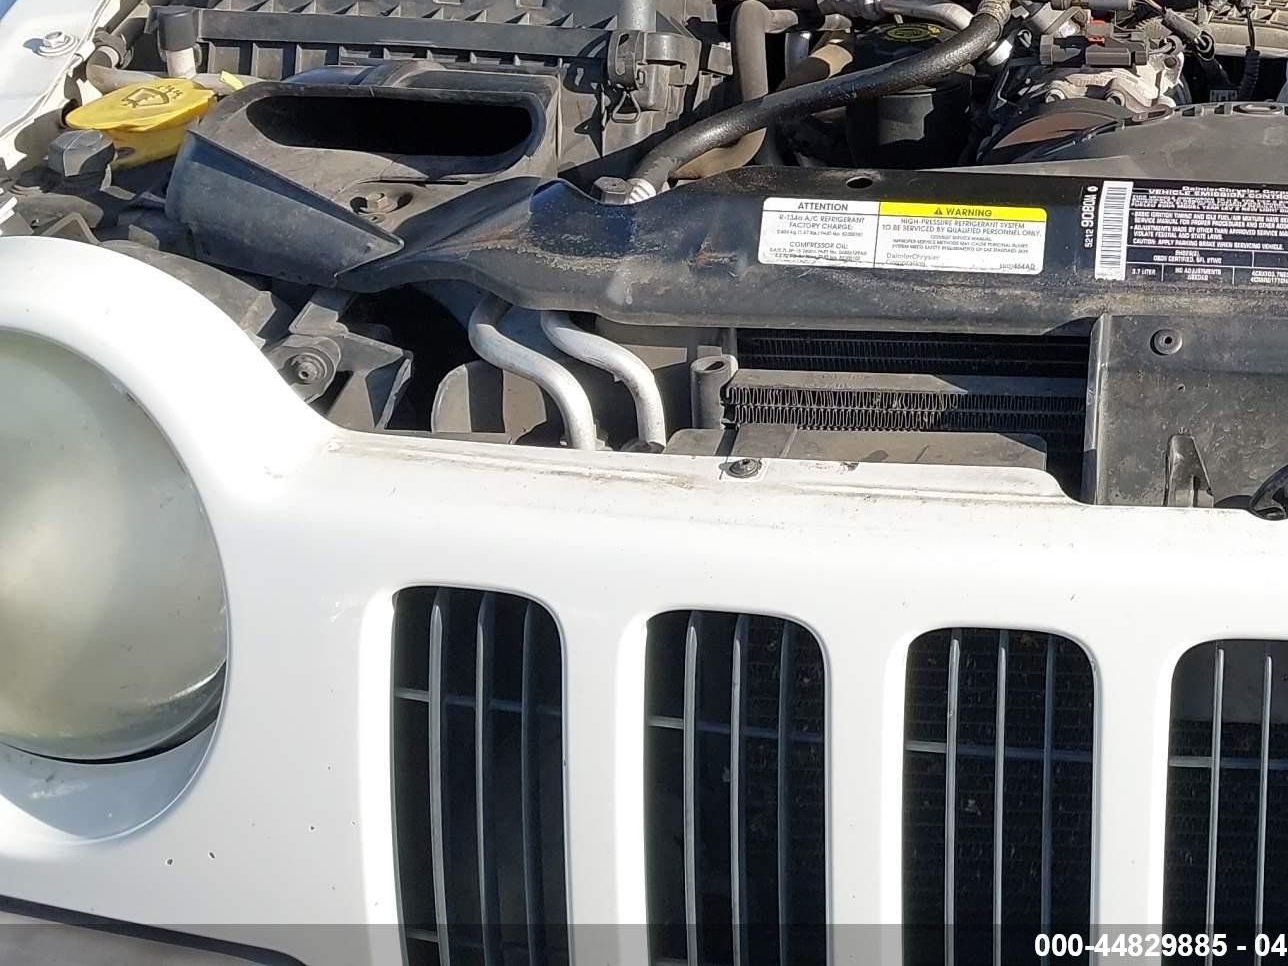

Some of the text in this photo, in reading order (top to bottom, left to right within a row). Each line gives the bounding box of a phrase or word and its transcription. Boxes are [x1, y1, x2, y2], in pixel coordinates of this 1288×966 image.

[1182, 185, 1261, 194] DaimlerChrysler
[1195, 191, 1246, 199] EMISSION
[798, 202, 849, 211] ATTENTION
[946, 208, 993, 217] WARNING
[820, 216, 865, 224] REFRIGERANT
[954, 220, 998, 228] REFRIGERANT
[983, 228, 1021, 236] PERSONNEL
[1133, 224, 1171, 232] ADJUSTMENTS
[789, 241, 834, 249] COMPRESSOR
[886, 253, 940, 261] DaimlerChrysler
